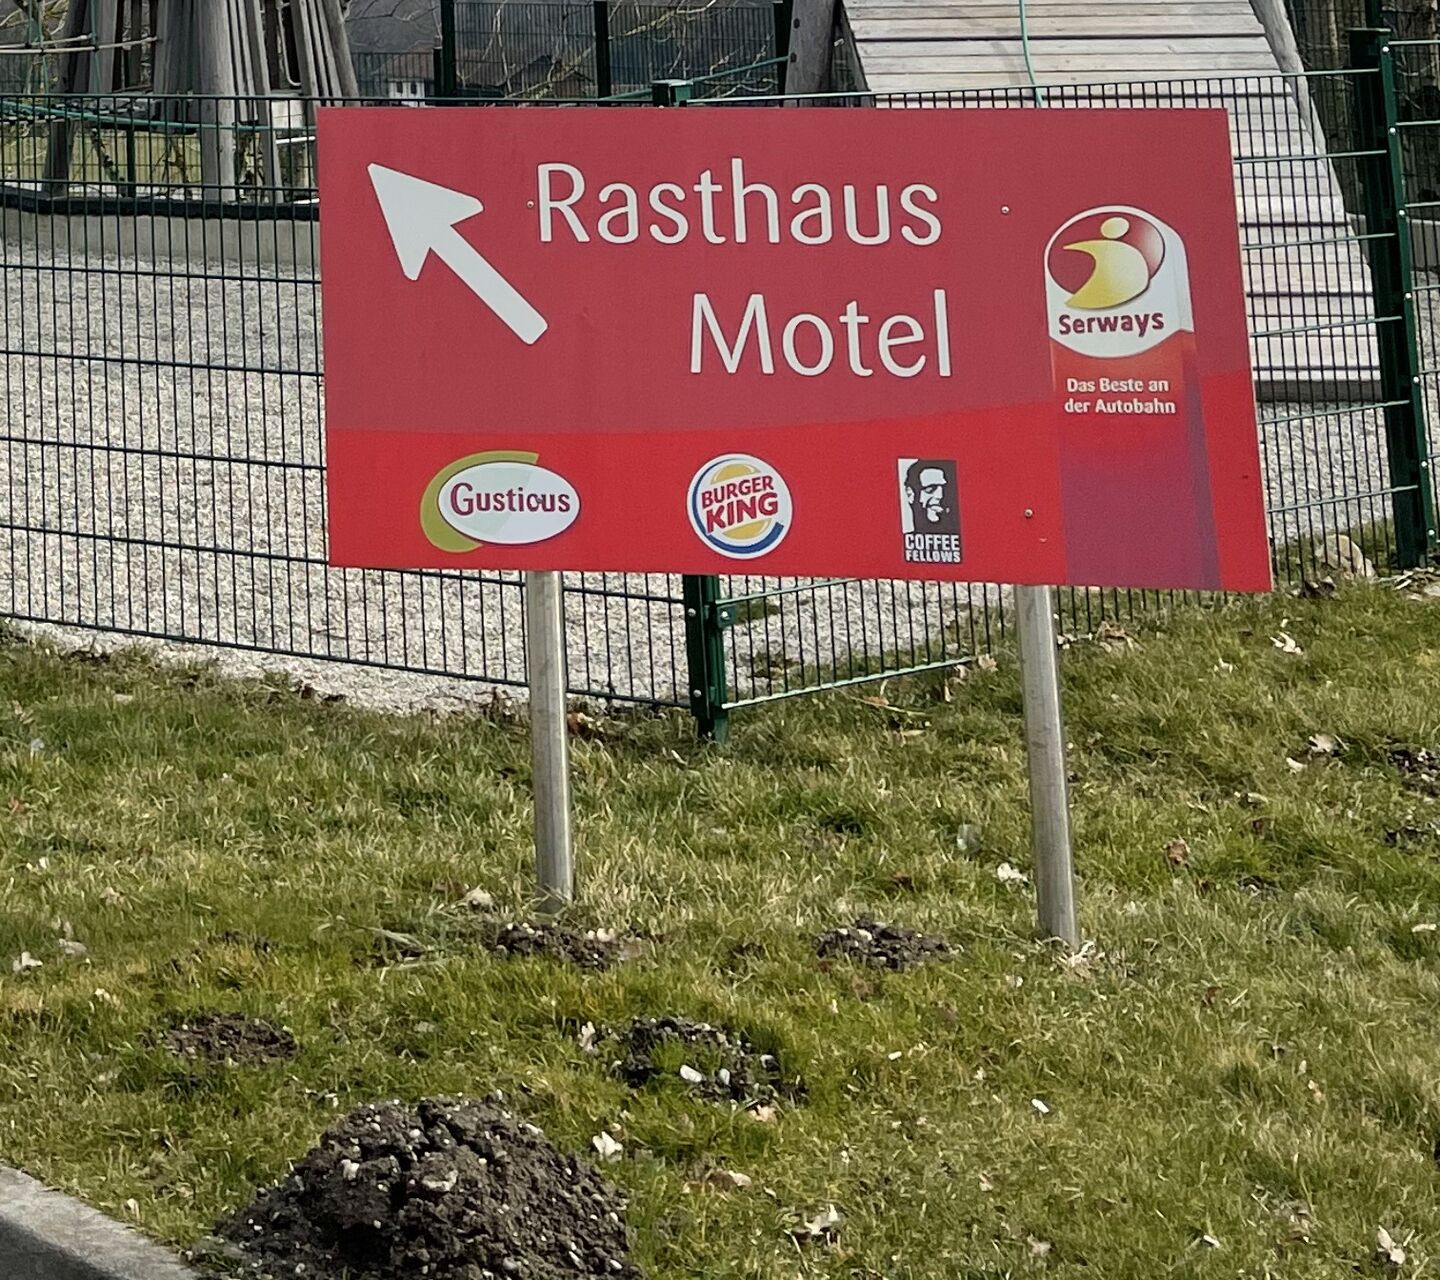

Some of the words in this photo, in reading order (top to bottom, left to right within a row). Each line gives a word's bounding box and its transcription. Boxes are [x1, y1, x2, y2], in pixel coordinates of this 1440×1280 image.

[537, 157, 942, 245] Rasthaus
[690, 288, 951, 378] Motel
[1059, 313, 1164, 337] Serways
[1066, 378, 1096, 392] Das
[1099, 378, 1144, 392] Beste
[1148, 380, 1169, 392] an
[1064, 398, 1090, 413] der
[1095, 398, 1176, 414] Autobahn
[450, 481, 570, 516] Gustious
[701, 475, 774, 509] BURGER
[705, 493, 779, 533] KING
[904, 534, 960, 551] COFFEE
[905, 551, 960, 563] FELLOWS
